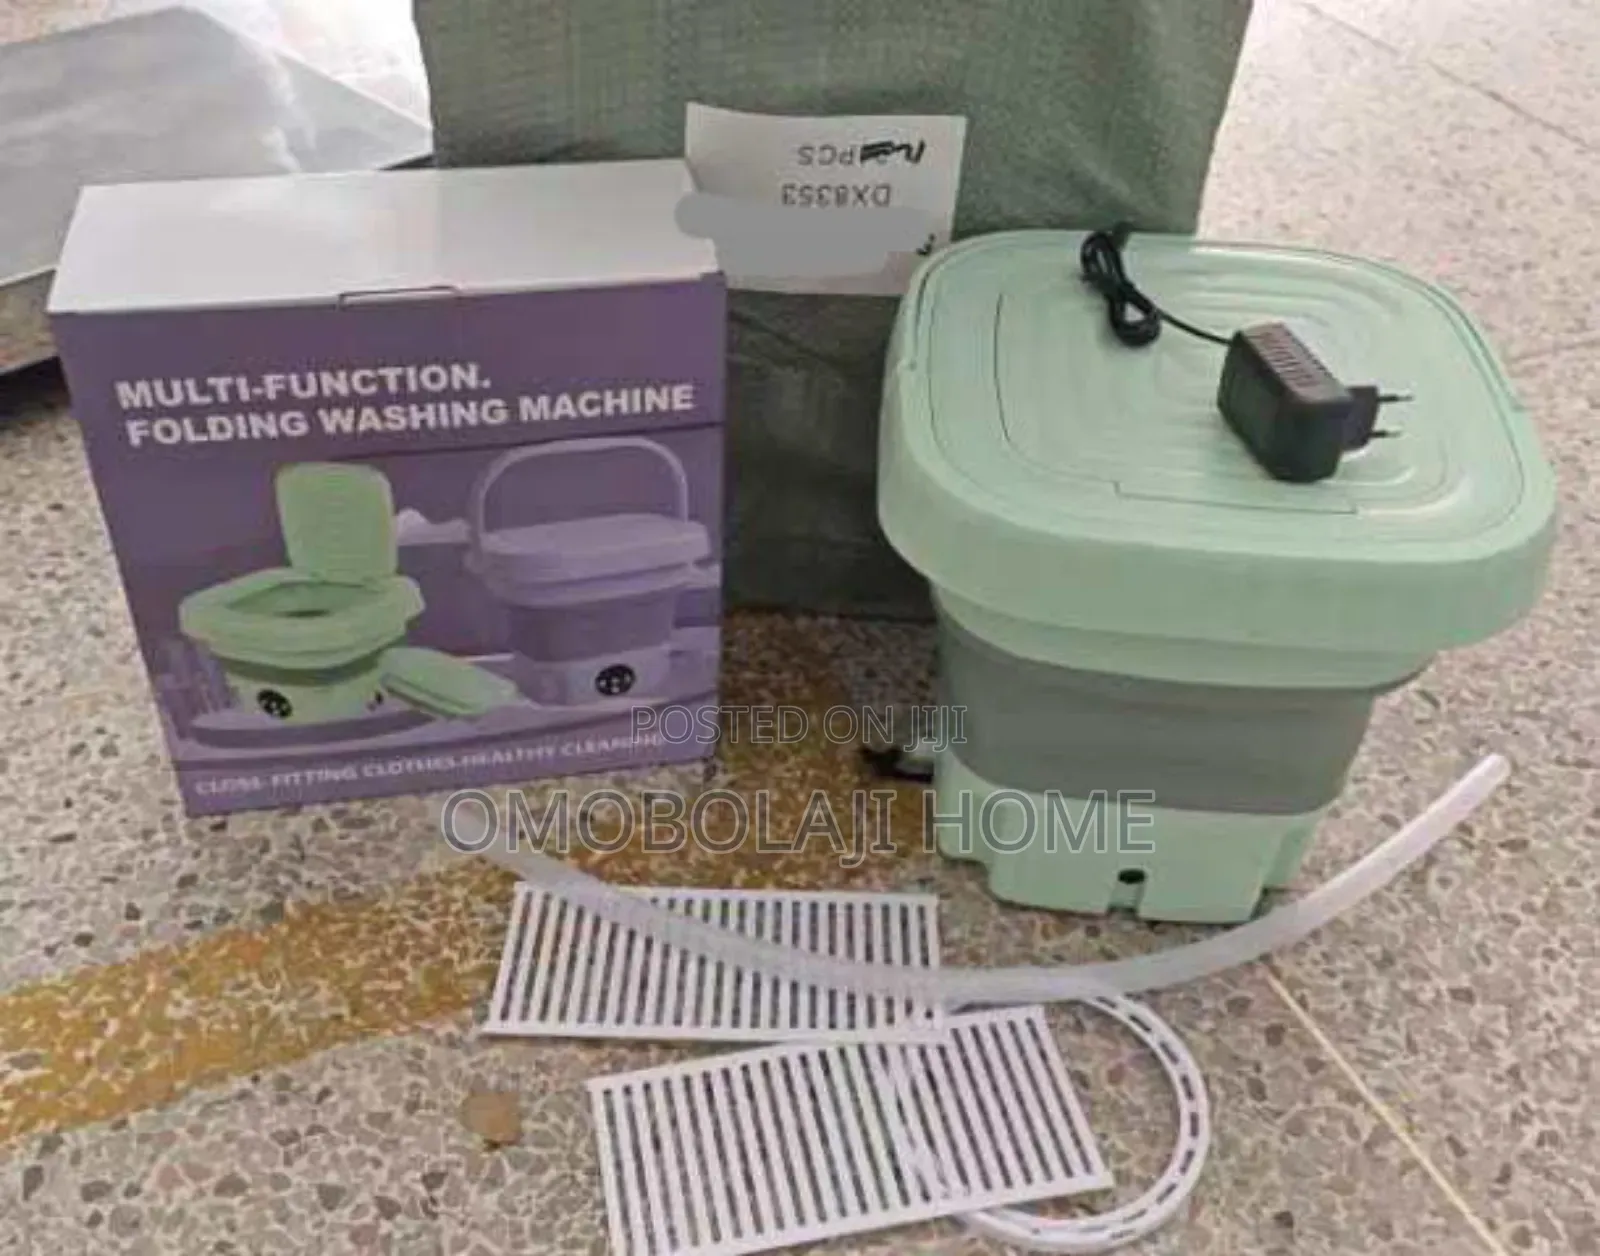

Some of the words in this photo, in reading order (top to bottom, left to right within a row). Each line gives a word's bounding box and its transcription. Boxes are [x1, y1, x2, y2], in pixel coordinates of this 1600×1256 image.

[114, 362, 491, 409] MULTI-FUNCTION.
[126, 409, 309, 446] FOLDING
[317, 398, 508, 435] WASHING
[517, 384, 695, 422] MACHINE
